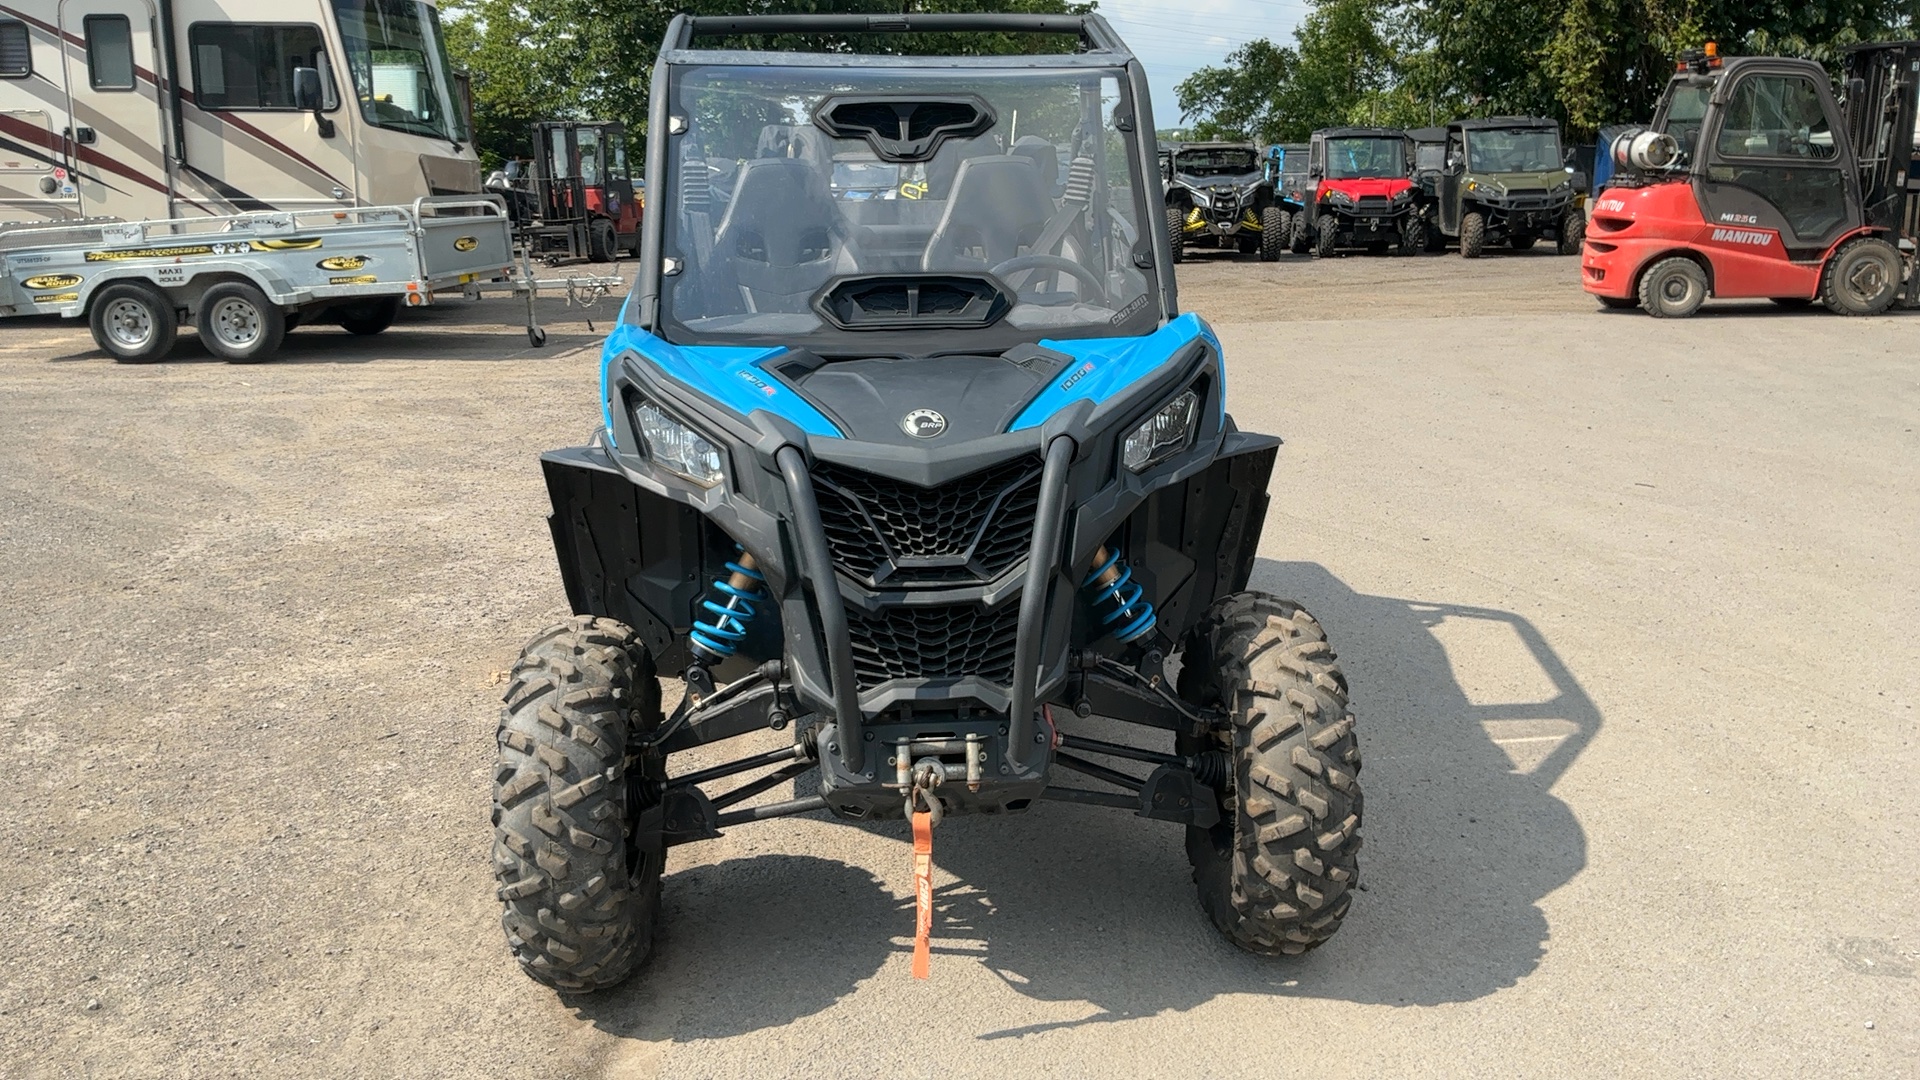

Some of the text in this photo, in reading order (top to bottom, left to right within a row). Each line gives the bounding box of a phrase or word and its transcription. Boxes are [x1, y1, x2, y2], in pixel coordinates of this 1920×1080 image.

[1711, 229, 1773, 246] MANITOU
[158, 268, 183, 276] MAXI
[45, 278, 77, 287] ROULE
[1060, 361, 1094, 392] 1000R
[920, 421, 943, 429] BRP
